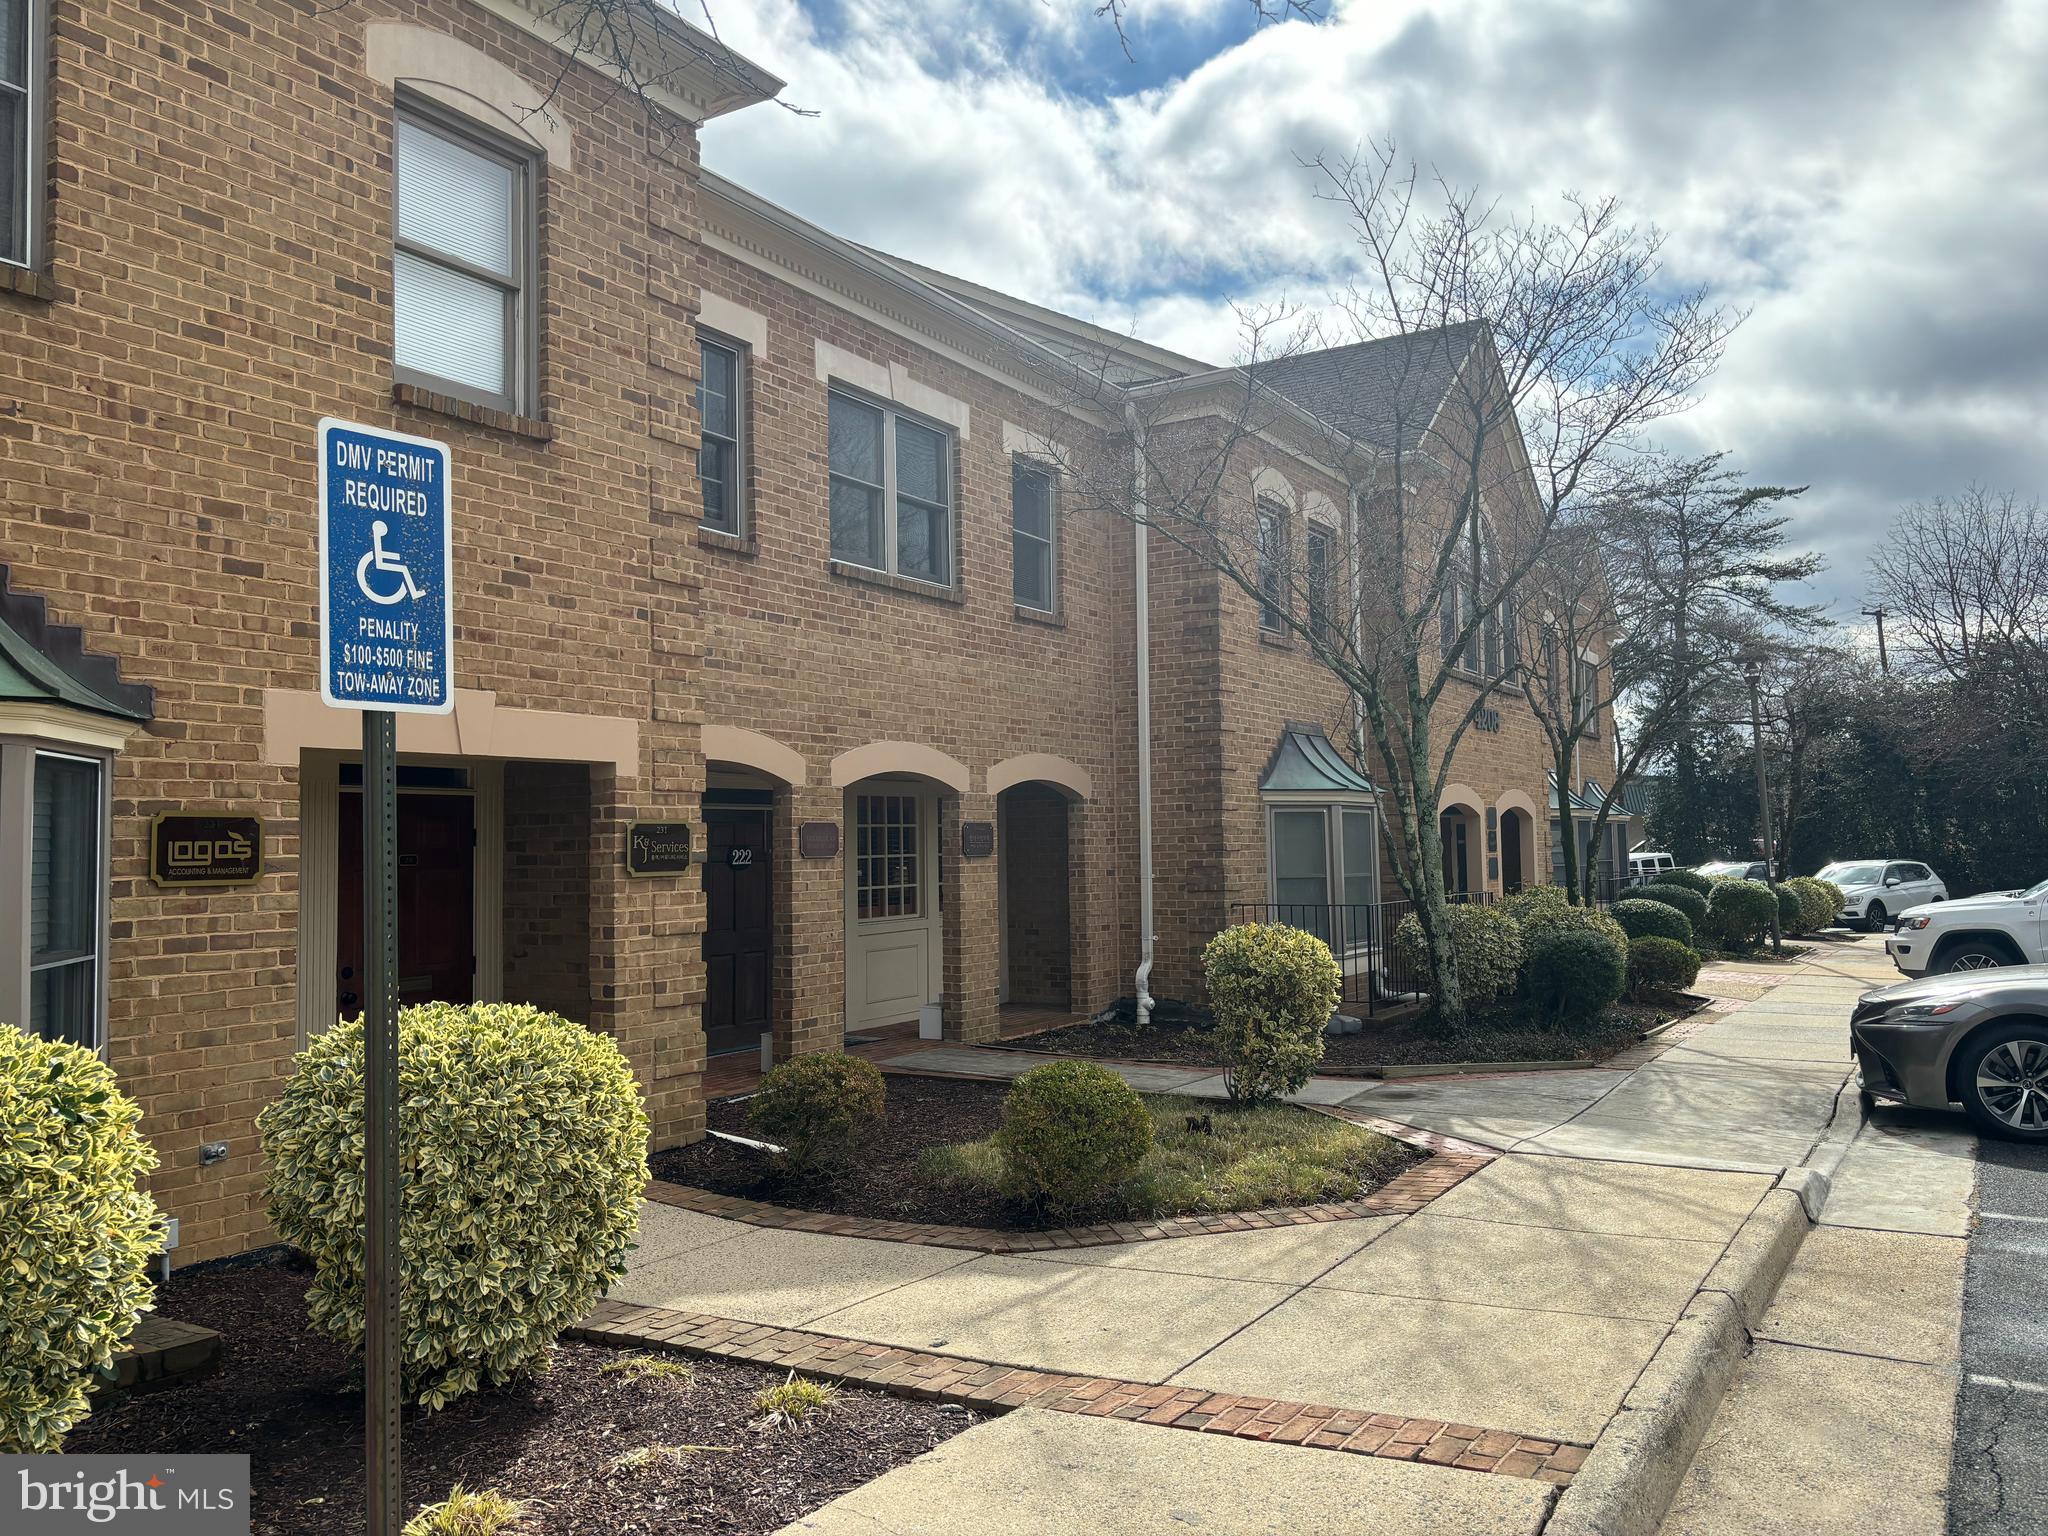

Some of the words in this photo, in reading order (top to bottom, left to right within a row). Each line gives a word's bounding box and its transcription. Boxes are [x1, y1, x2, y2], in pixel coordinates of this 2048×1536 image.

[337, 440, 372, 471] DMV
[377, 448, 435, 483] PERMIT
[345, 479, 427, 517] REQUIRED
[359, 617, 419, 641] PENALITY
[344, 643, 403, 667] $100-$500
[407, 649, 433, 670] FINE
[337, 671, 404, 695] TOW-AWAY
[408, 677, 440, 697] ZONE
[656, 826, 668, 834] 231
[651, 840, 689, 853] Services
[732, 849, 752, 865] 222
[168, 867, 206, 876] ACCOUNTING
[212, 867, 249, 875] MANAGEMENT
